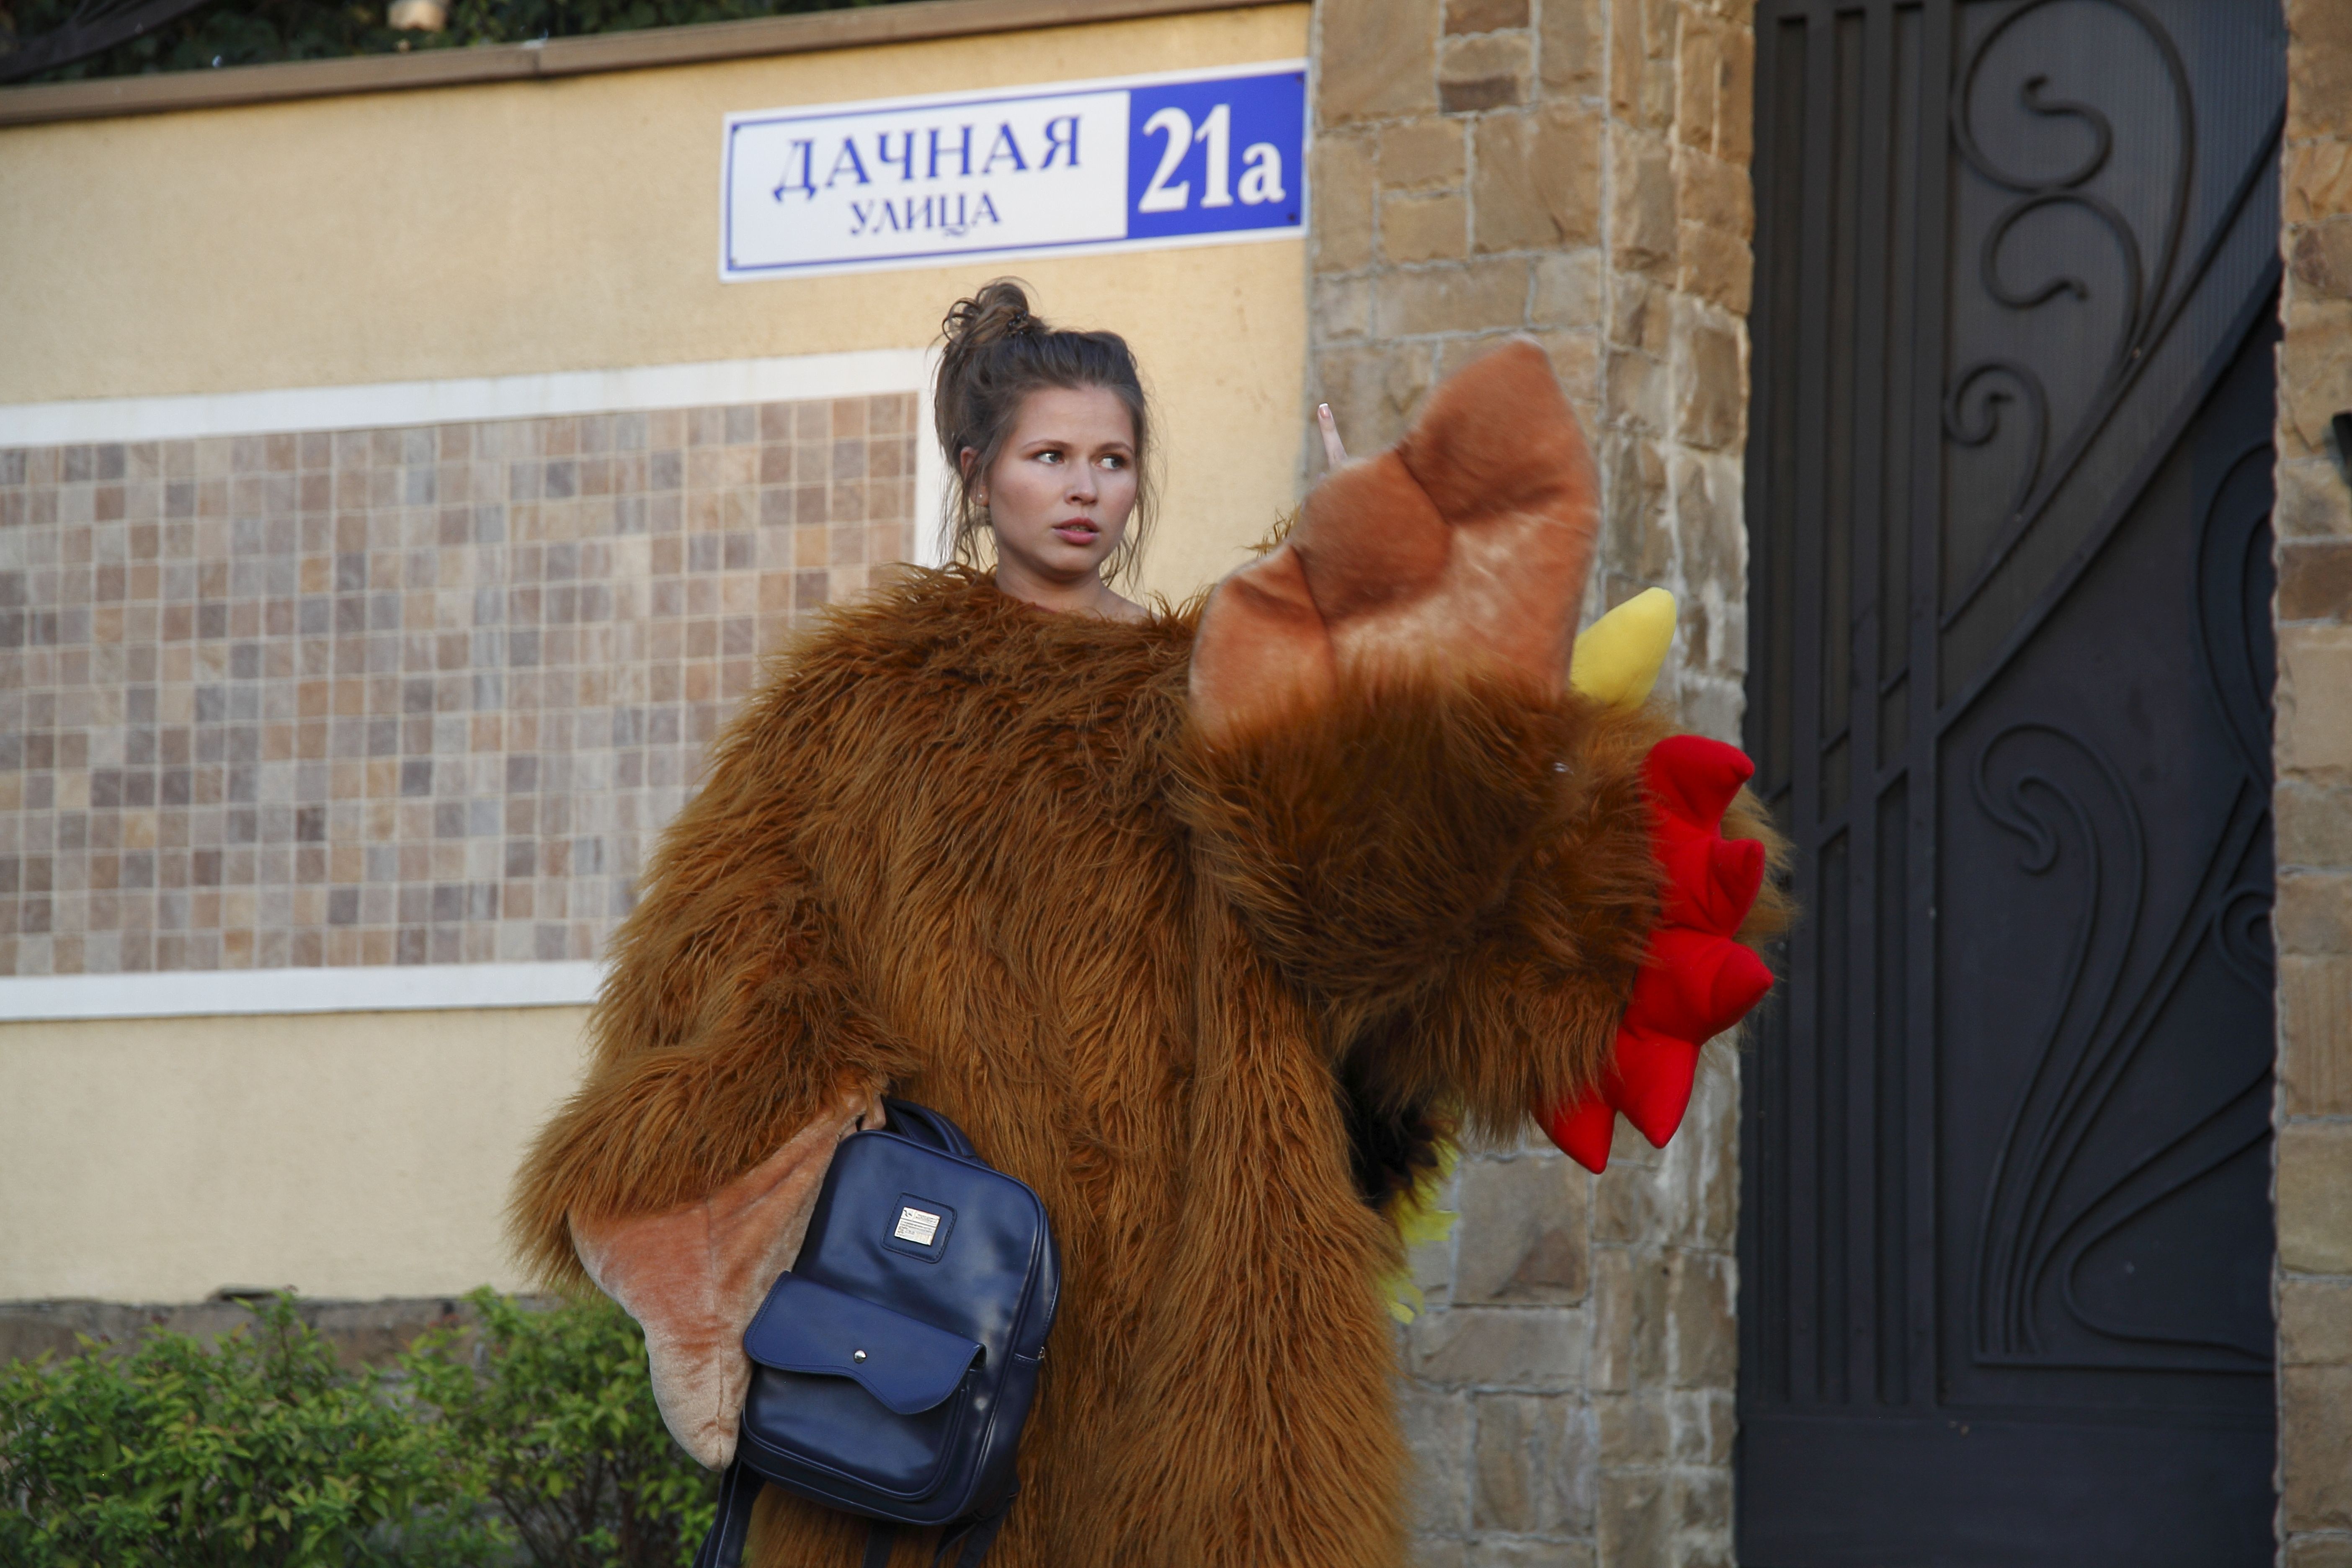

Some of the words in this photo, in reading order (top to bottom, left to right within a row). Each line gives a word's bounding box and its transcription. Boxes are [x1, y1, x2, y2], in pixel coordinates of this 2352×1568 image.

[772, 114, 1082, 202] ДАЧНАЯ
[1138, 104, 1286, 214] 21а
[849, 193, 1003, 237] УЛИЦА
